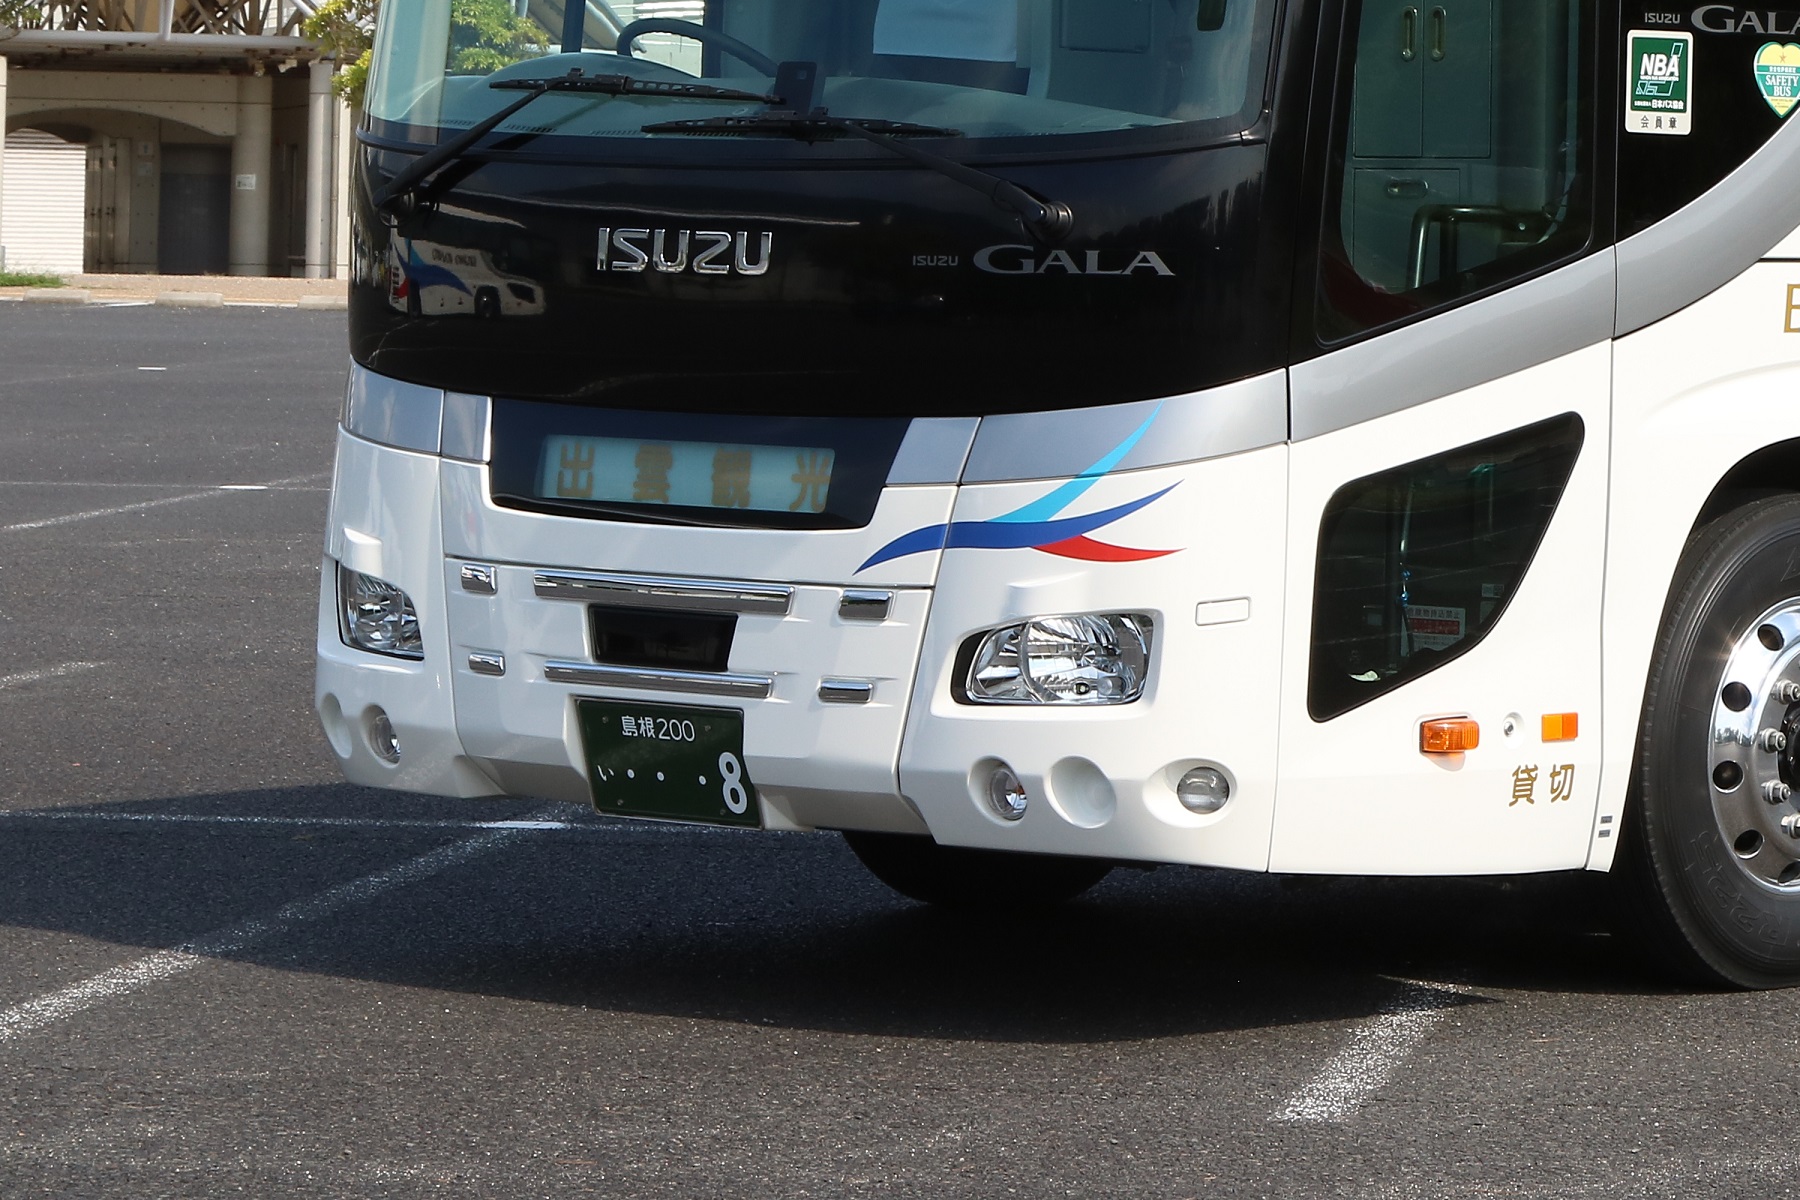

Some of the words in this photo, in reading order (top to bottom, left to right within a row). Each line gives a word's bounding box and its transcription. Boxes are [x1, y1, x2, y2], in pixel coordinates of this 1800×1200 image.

[1644, 12, 1681, 24] ISUZU
[1640, 53, 1680, 76] NBA
[1765, 74, 1799, 88] SAFETY
[1773, 86, 1792, 97] BUS
[1651, 99, 1684, 110] 日本バス協会
[1640, 115, 1678, 129] 会員章
[596, 227, 773, 275] ISUZU
[912, 255, 959, 267] ISUZU
[973, 244, 1176, 276] GALA
[556, 441, 831, 512] 出雲観光
[1508, 764, 1575, 807] 貸切
